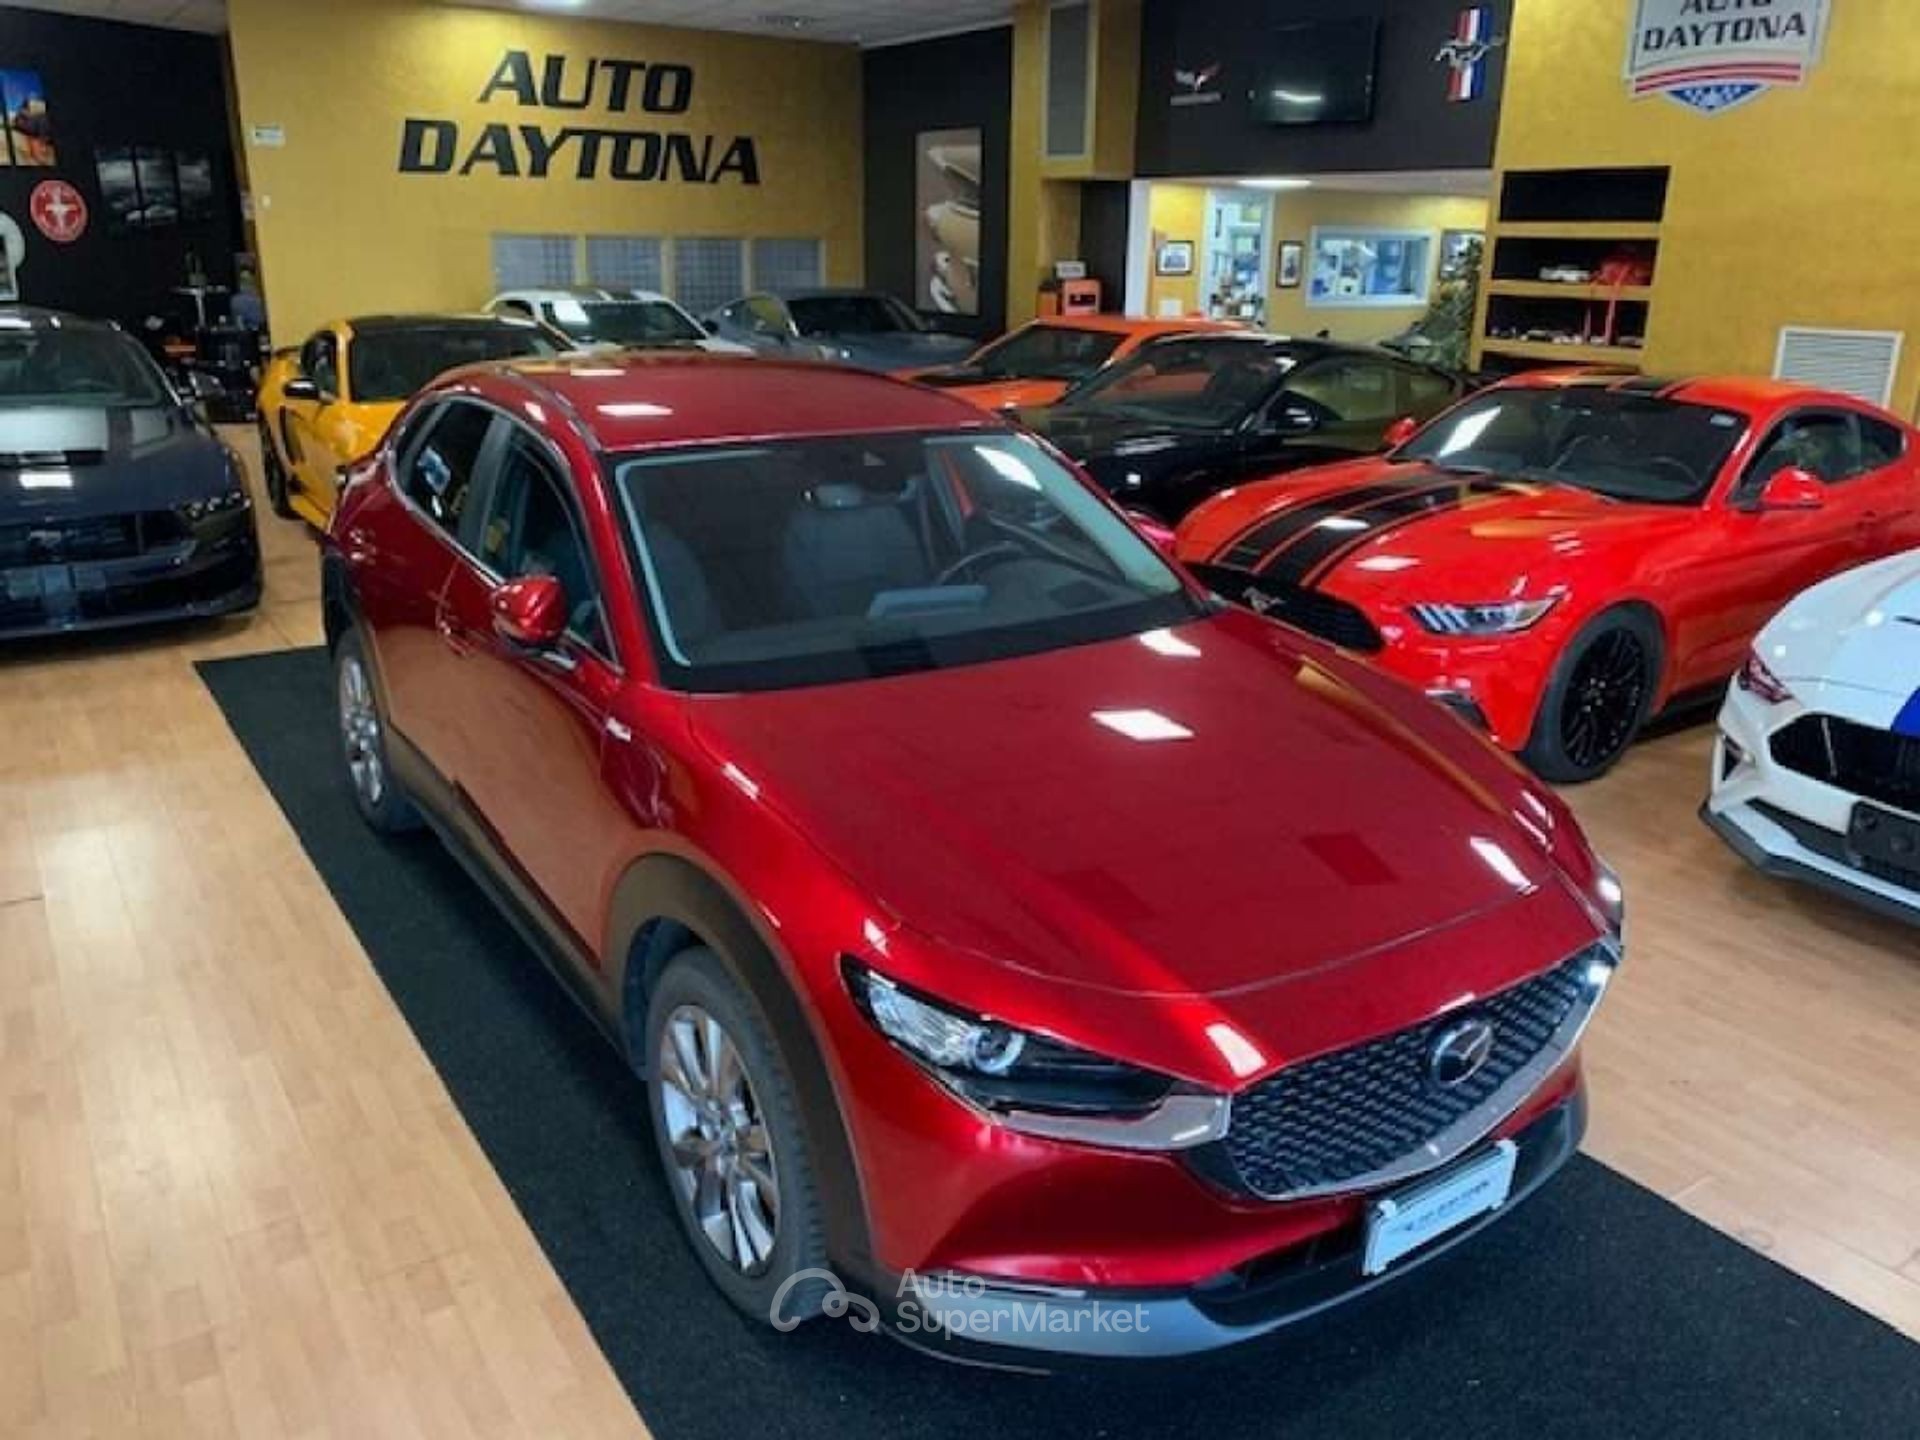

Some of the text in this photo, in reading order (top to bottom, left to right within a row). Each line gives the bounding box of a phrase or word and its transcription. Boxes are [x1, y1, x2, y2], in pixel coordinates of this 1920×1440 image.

[1643, 12, 1806, 50] DAYTONA
[477, 50, 694, 115] AUTO
[398, 118, 761, 185] DAYTONA
